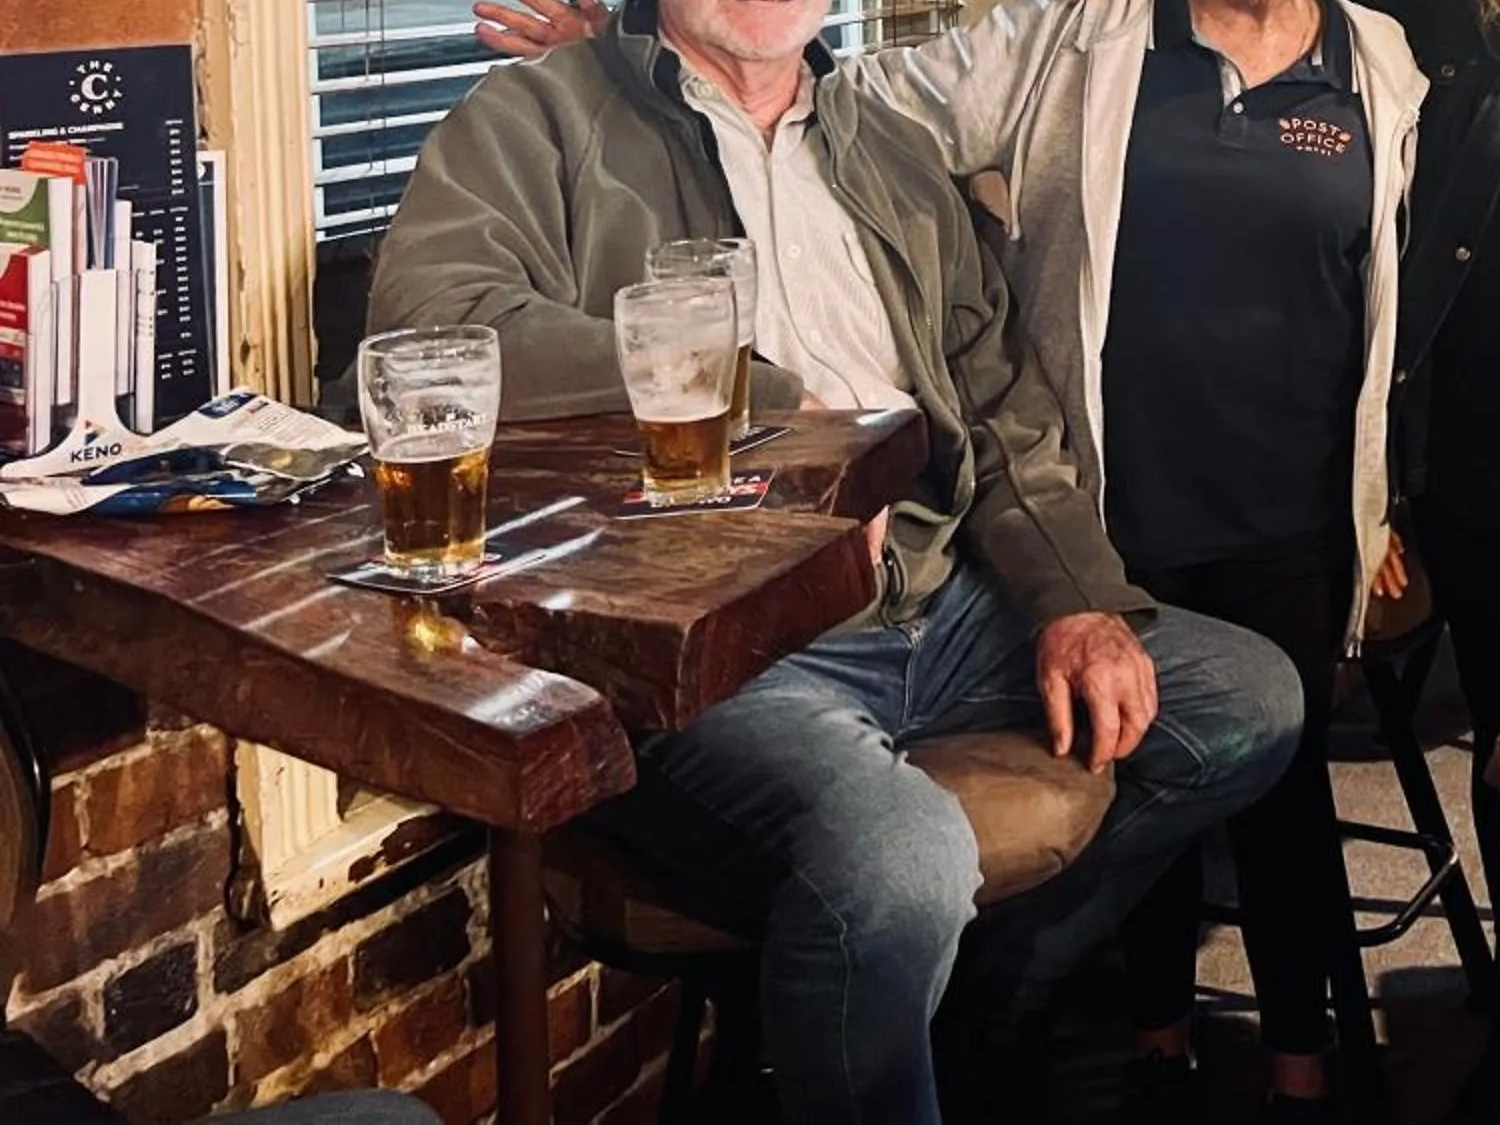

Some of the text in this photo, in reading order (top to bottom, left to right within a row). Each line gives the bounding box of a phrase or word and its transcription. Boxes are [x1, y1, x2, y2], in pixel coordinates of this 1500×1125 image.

[81, 73, 109, 101] C
[1291, 118, 1341, 136] POST
[1280, 132, 1346, 154] OFFICE
[70, 442, 122, 463] KENO
